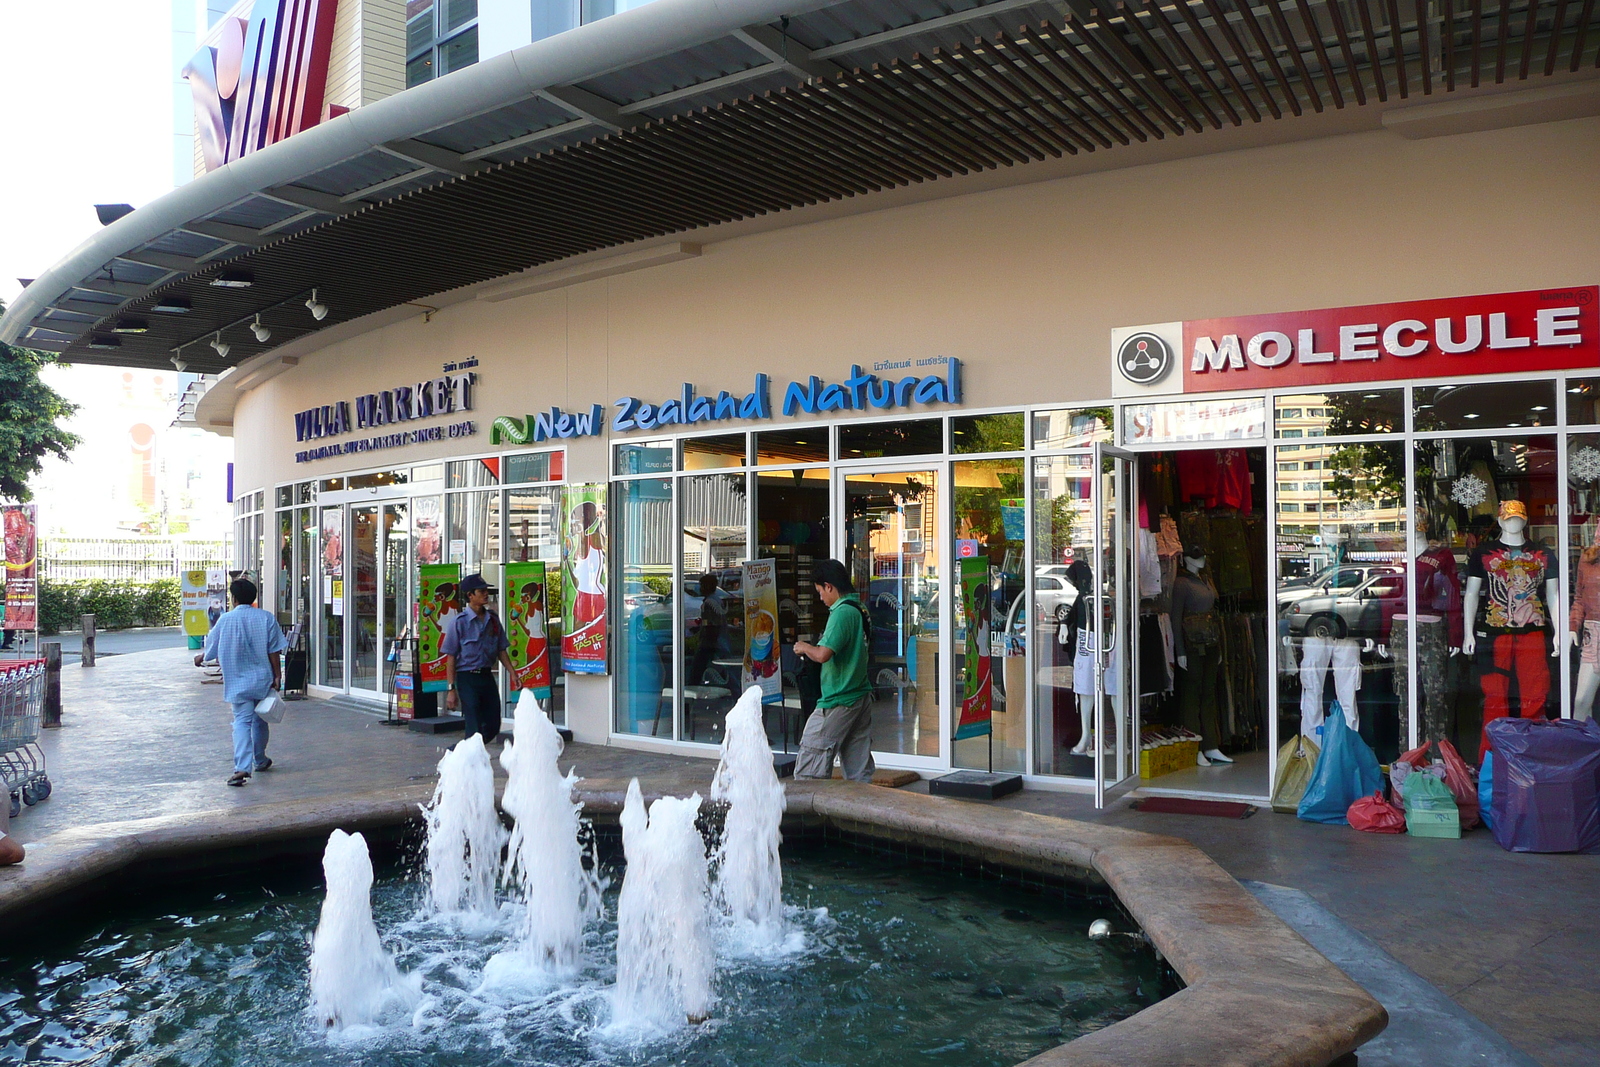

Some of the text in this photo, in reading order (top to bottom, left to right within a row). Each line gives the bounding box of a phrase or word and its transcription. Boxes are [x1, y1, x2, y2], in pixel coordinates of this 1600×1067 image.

[1190, 306, 1582, 373] MOLECULE
[294, 372, 477, 442] VILLA MARKET
[534, 357, 963, 442] New Zealand Natural
[343, 432, 409, 454] SUPERMARKET
[410, 425, 445, 444] SINCE
[448, 420, 476, 438] 1974
[572, 632, 586, 645] JUST
[573, 632, 605, 652] TASTE
[520, 666, 544, 684] TASTE
